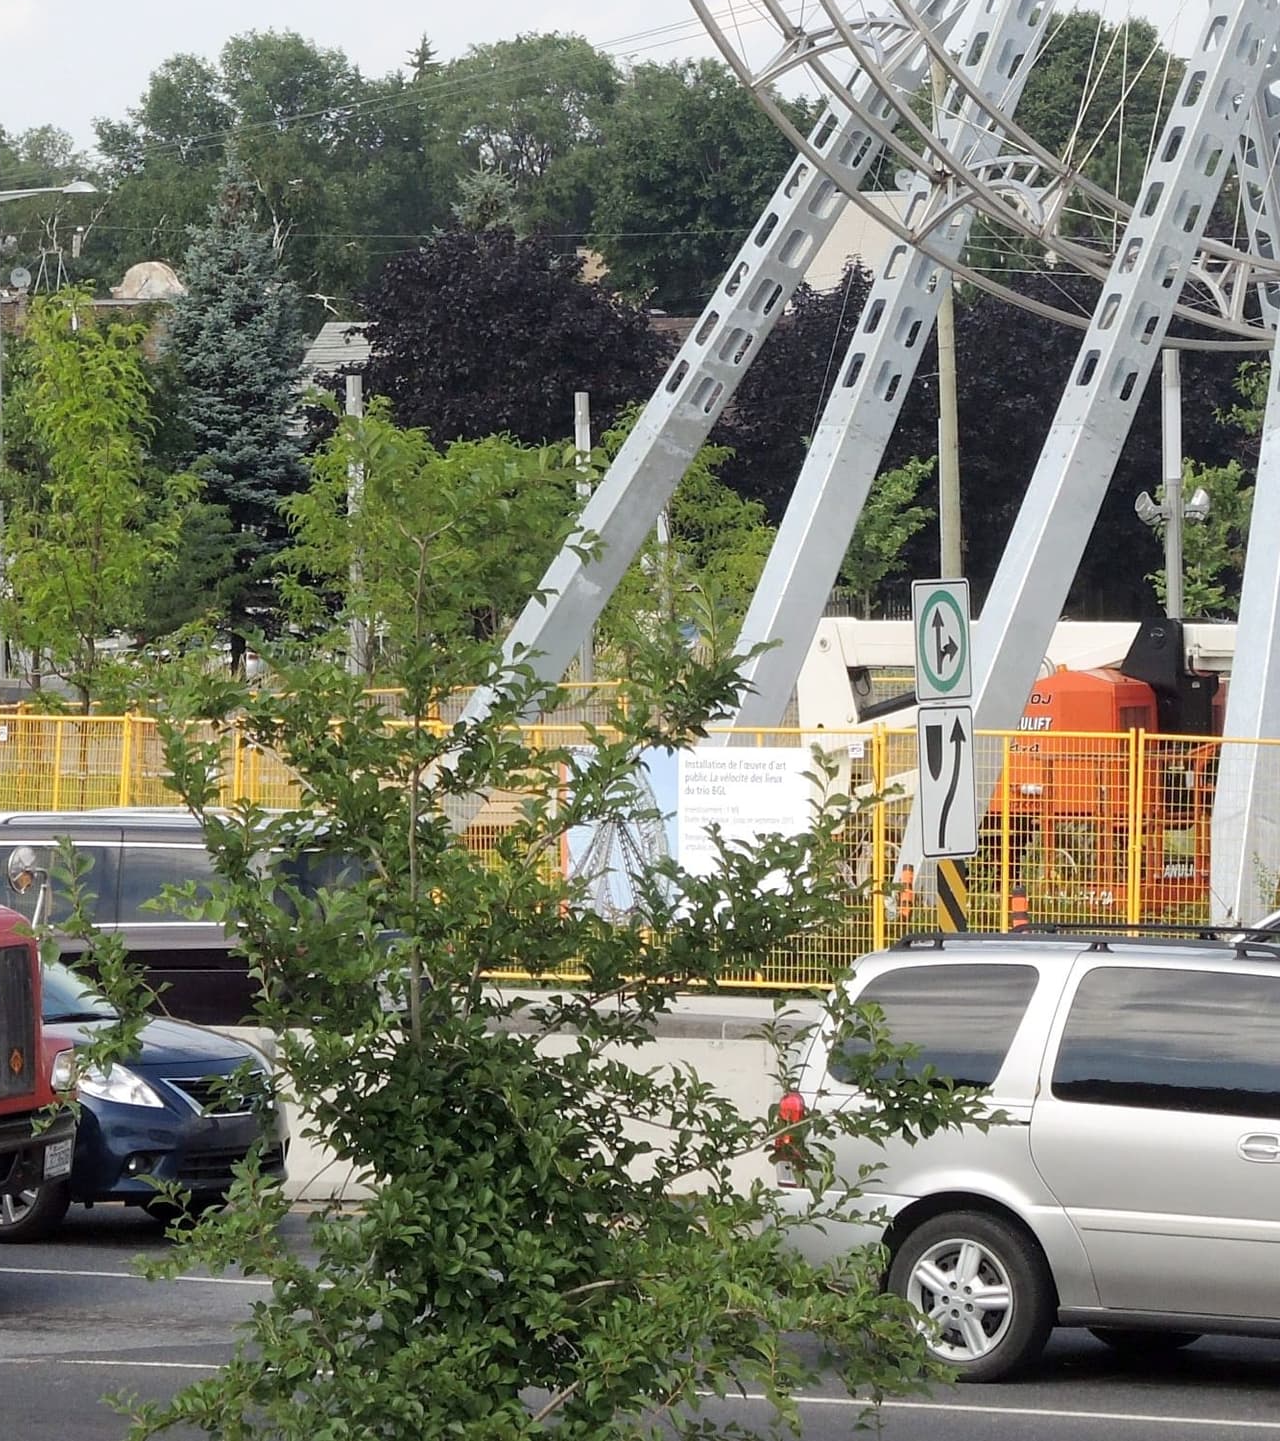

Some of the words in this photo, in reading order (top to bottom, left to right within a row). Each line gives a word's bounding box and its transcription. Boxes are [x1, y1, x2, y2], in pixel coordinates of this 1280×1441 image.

[685, 760, 726, 769] Installation
[728, 760, 737, 769] de
[685, 772, 708, 784] public
[750, 773, 763, 783] des
[684, 785, 695, 795] du
[696, 785, 710, 795] trio
